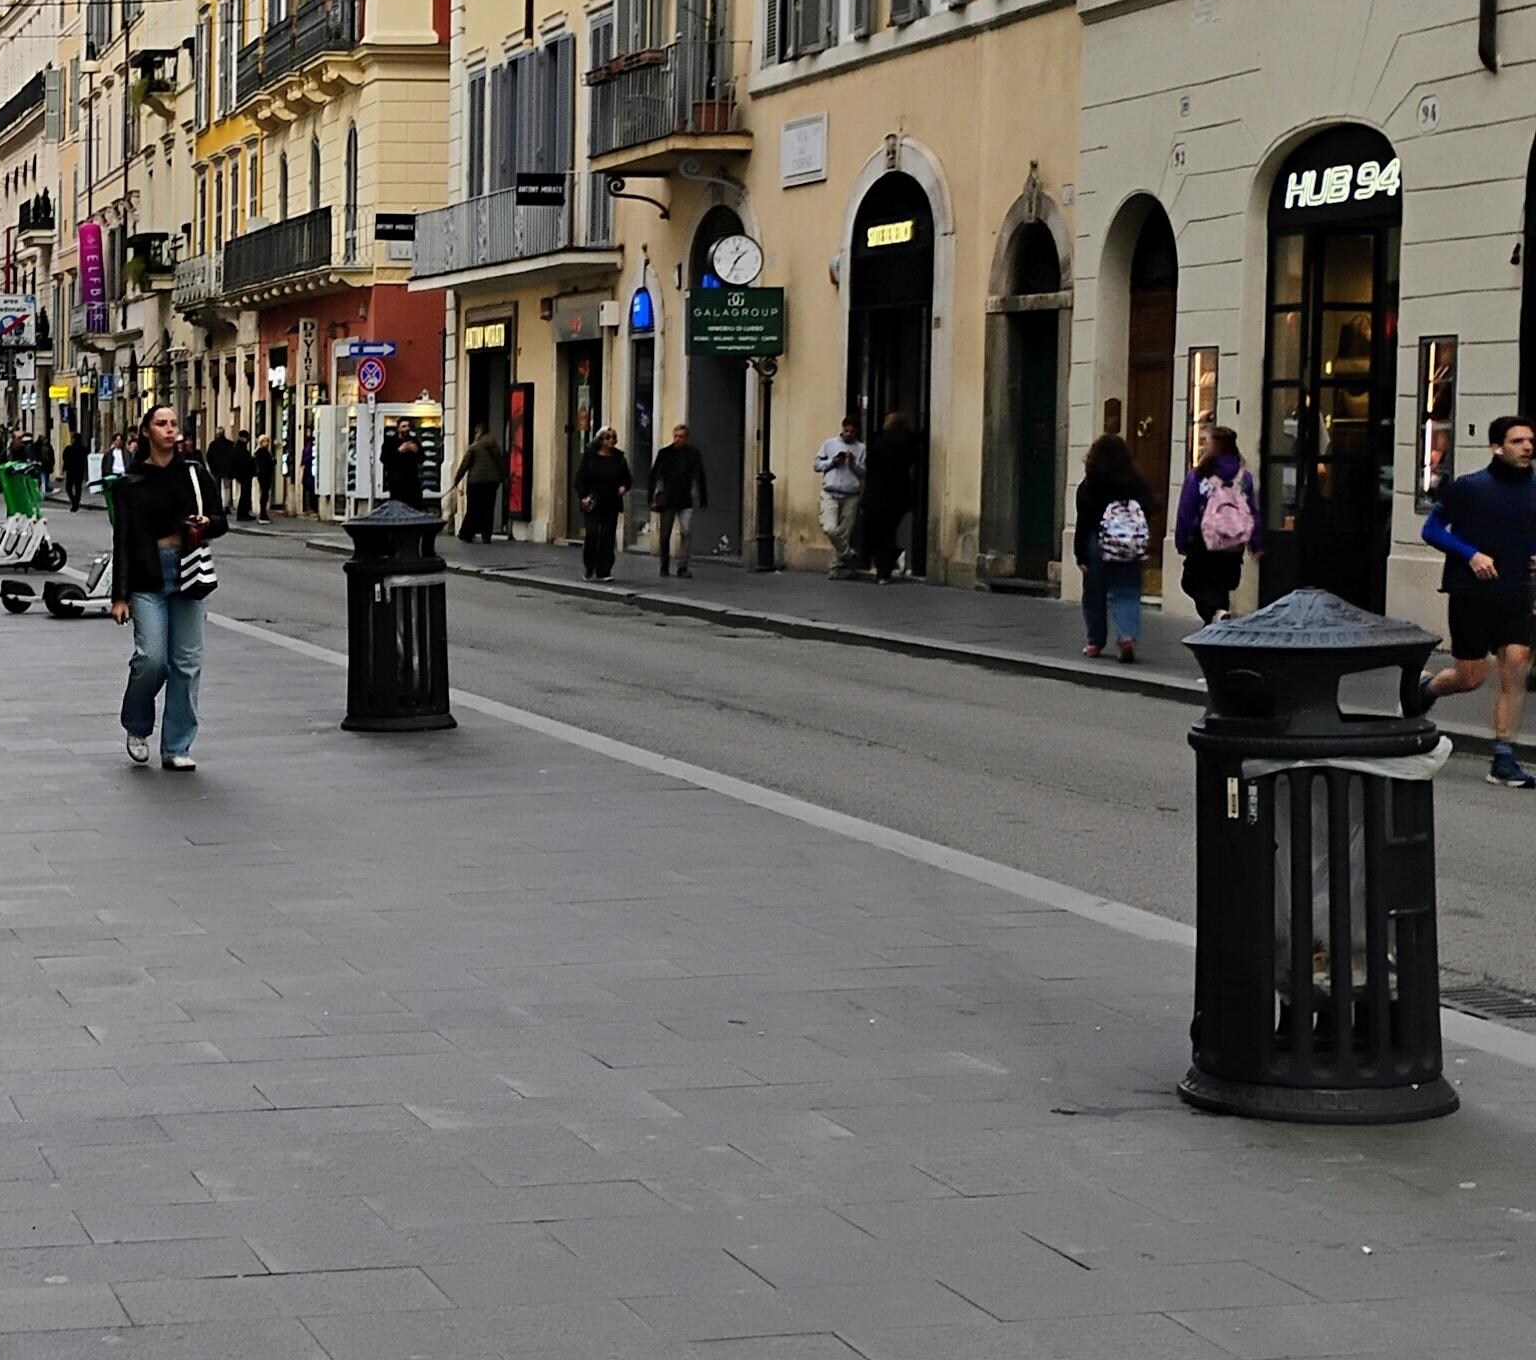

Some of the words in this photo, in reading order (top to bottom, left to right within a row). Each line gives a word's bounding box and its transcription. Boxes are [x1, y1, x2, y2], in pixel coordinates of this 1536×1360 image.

[1285, 165, 1353, 209] HUB
[1355, 158, 1401, 201] 94
[693, 308, 779, 317] GALAGROUP
